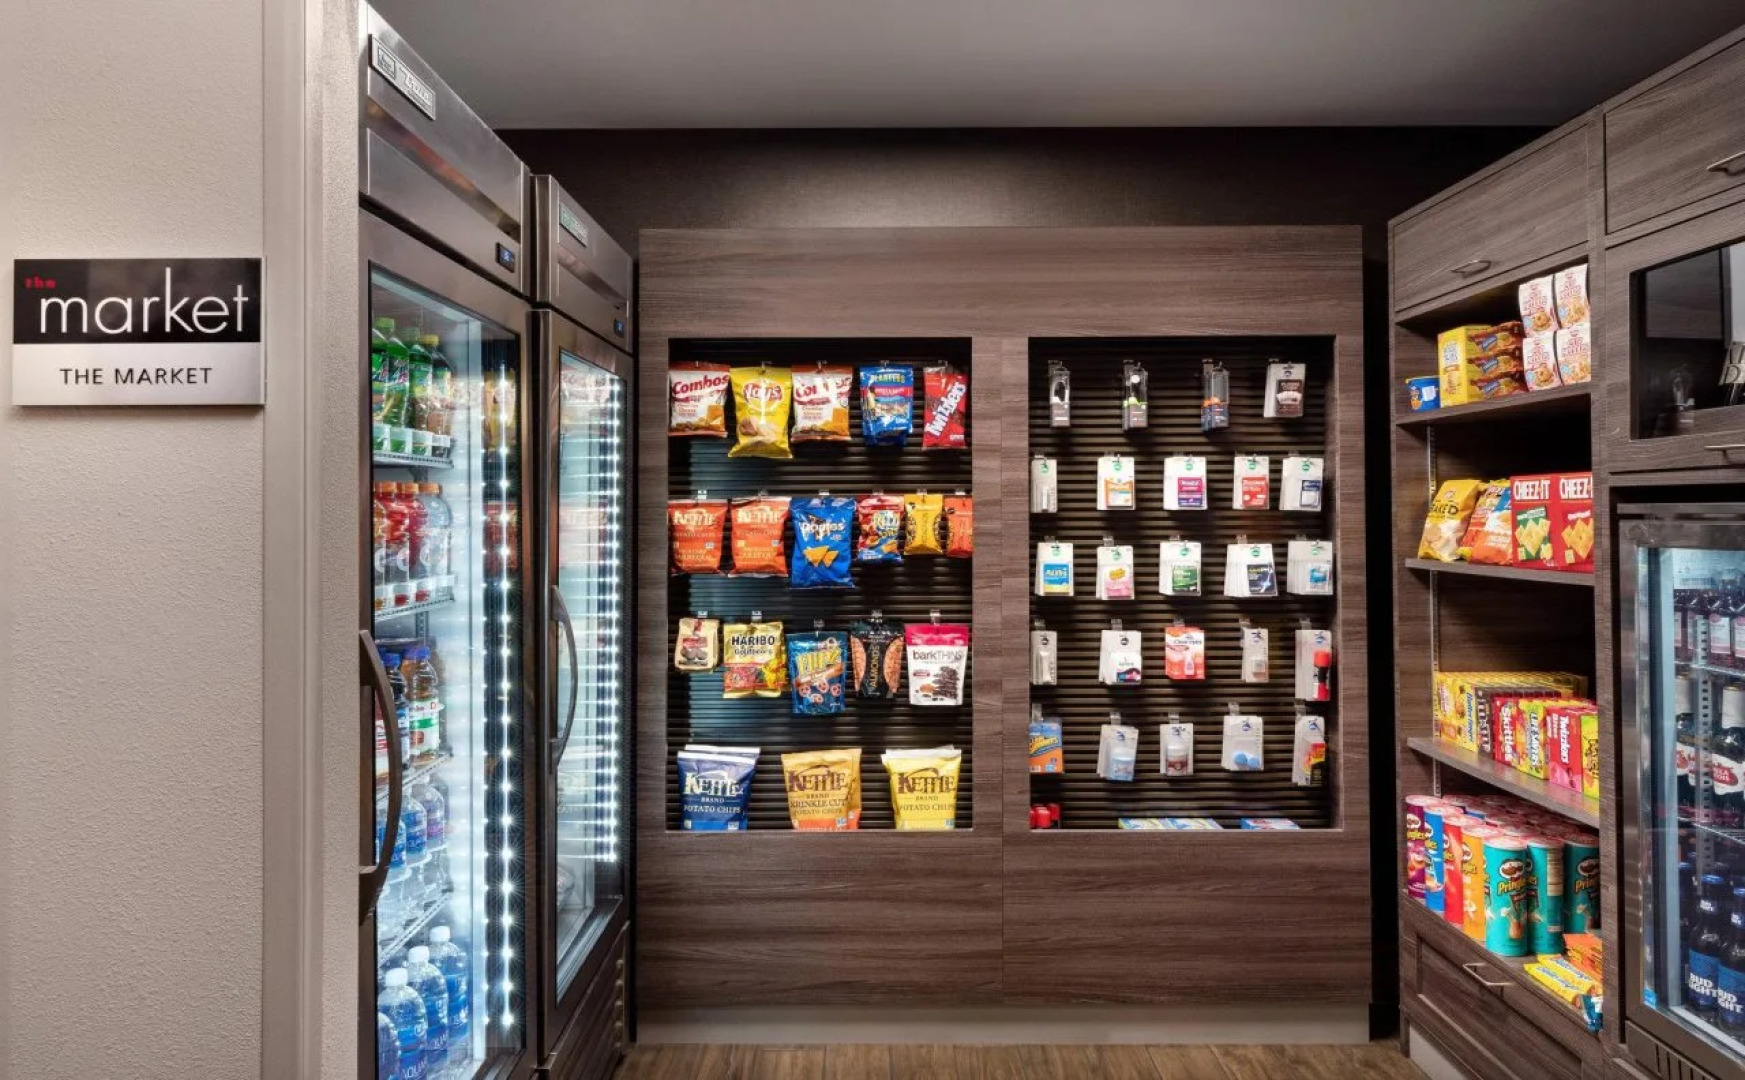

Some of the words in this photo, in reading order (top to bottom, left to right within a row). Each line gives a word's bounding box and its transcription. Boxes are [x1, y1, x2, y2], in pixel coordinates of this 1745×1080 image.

[40, 266, 249, 335] market
[60, 367, 103, 385] THE
[115, 367, 213, 384] MARKET
[672, 374, 729, 396] Combos
[1513, 479, 1551, 500] CHEEZ-IT
[731, 636, 775, 646] HARIBO
[900, 803, 930, 811] POTATO
[932, 803, 955, 811] CHIPS
